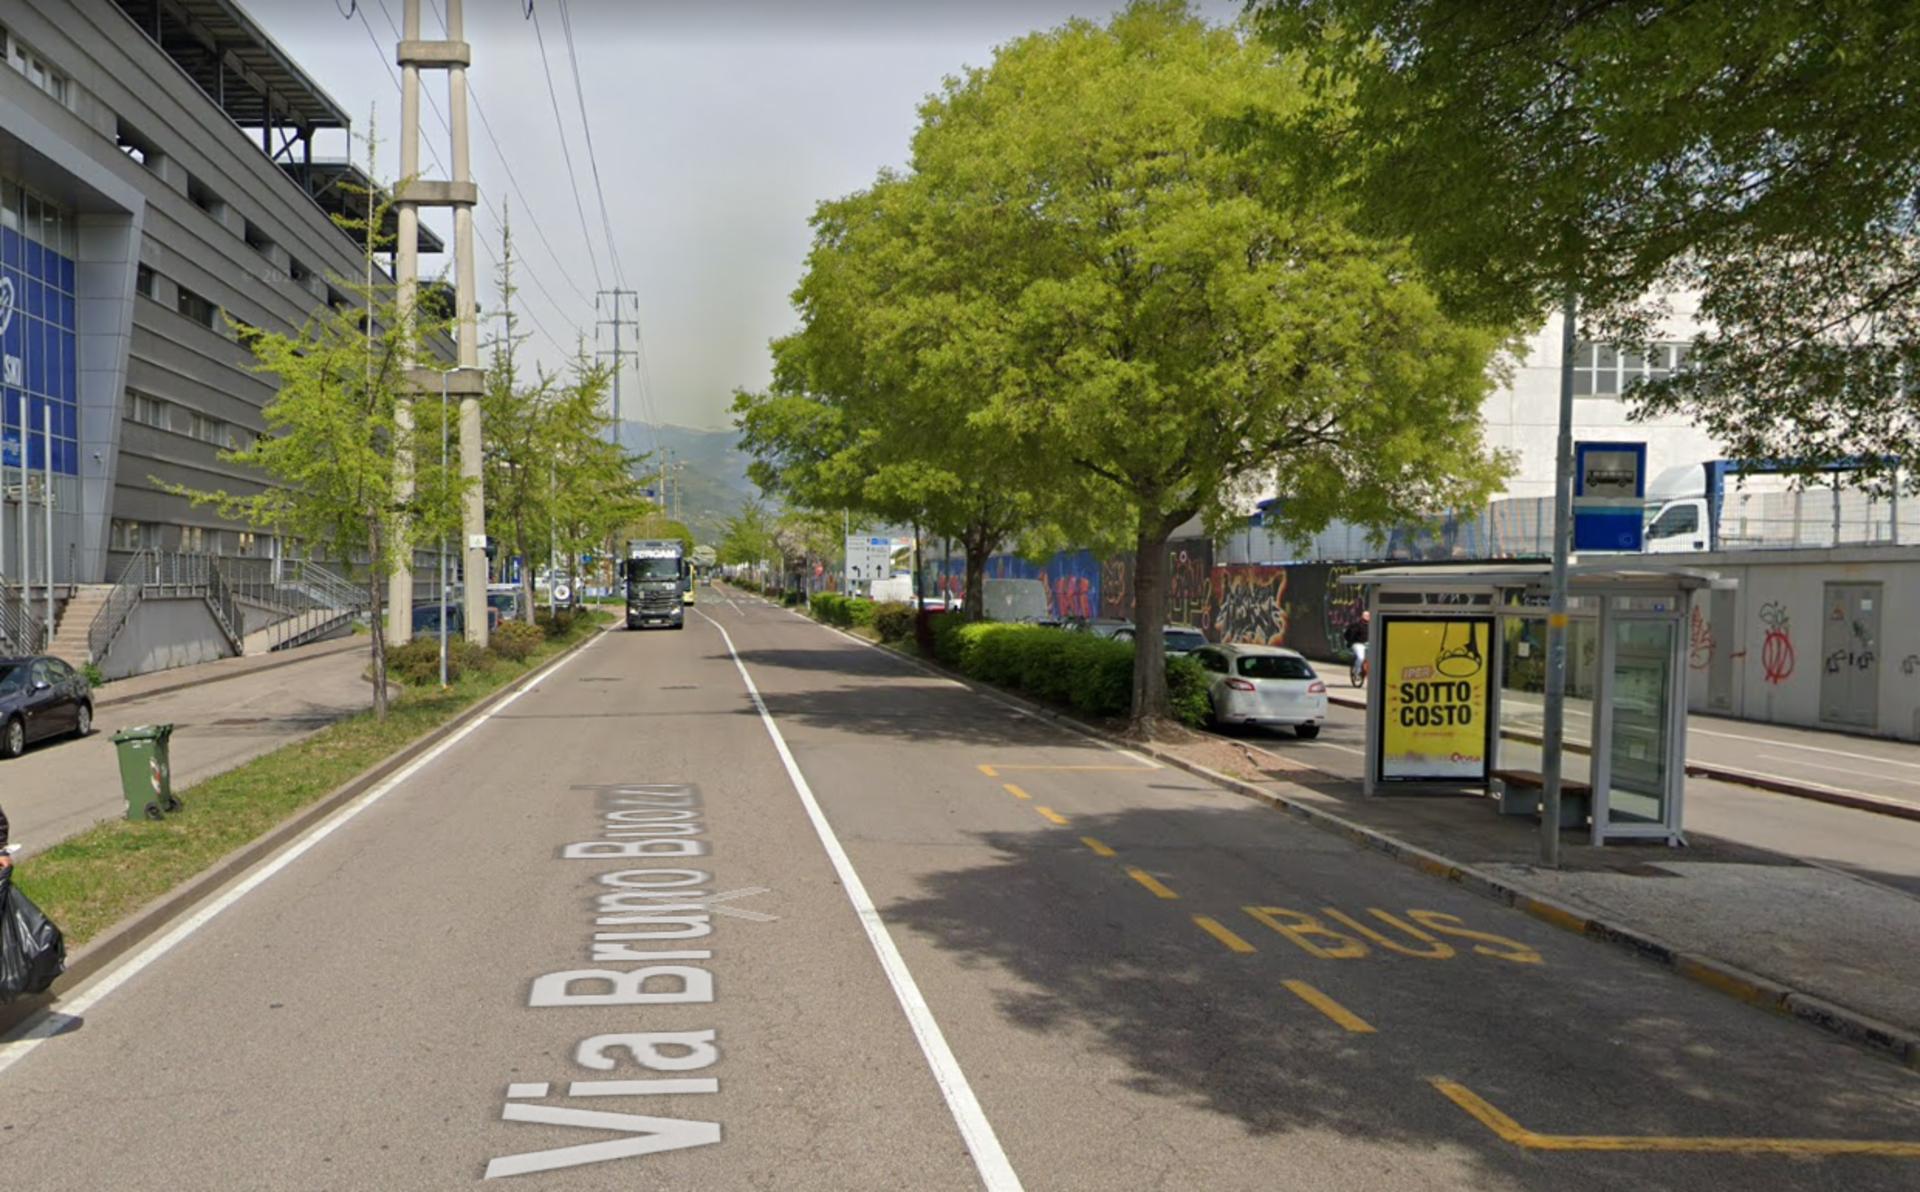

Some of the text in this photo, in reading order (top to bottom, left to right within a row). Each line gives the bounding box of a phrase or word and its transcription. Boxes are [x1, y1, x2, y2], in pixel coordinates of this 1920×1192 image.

[1401, 681, 1471, 704] SOTTO
[1401, 704, 1471, 727] COSTO
[1242, 905, 1544, 964] BUS
